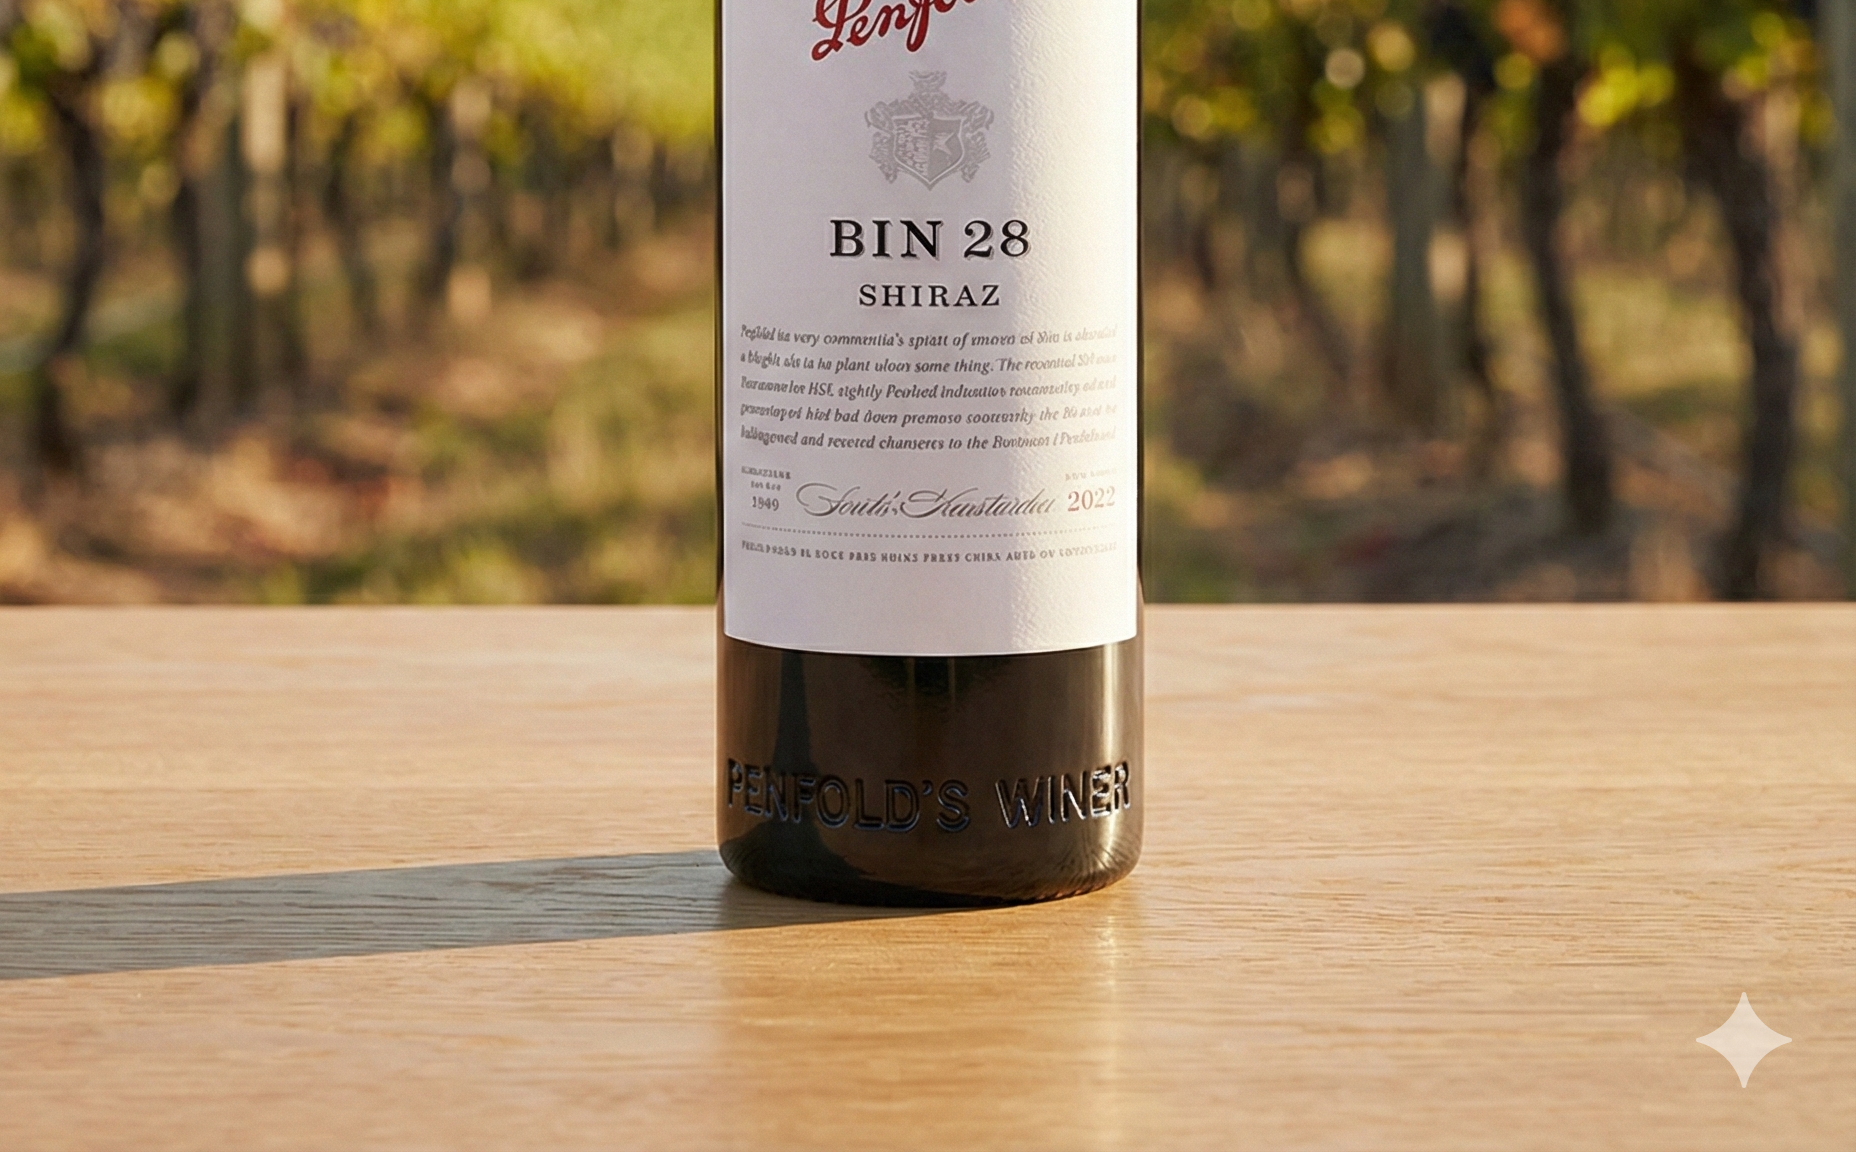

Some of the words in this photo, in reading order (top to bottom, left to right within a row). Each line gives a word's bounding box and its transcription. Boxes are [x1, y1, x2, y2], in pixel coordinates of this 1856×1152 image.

[829, 219, 942, 259] BIN
[963, 219, 1030, 259] 28
[858, 284, 1000, 308] SHIRAZ
[952, 332, 970, 350] of
[835, 357, 870, 374] plant
[914, 362, 951, 373] some
[954, 359, 994, 375] thing.
[996, 358, 1023, 372] The
[801, 432, 825, 447] and
[949, 438, 962, 449] to
[967, 436, 988, 449] the
[1067, 486, 1116, 512] 2022
[728, 758, 970, 833] PENFOLD'S
[994, 761, 1131, 830] WINER
